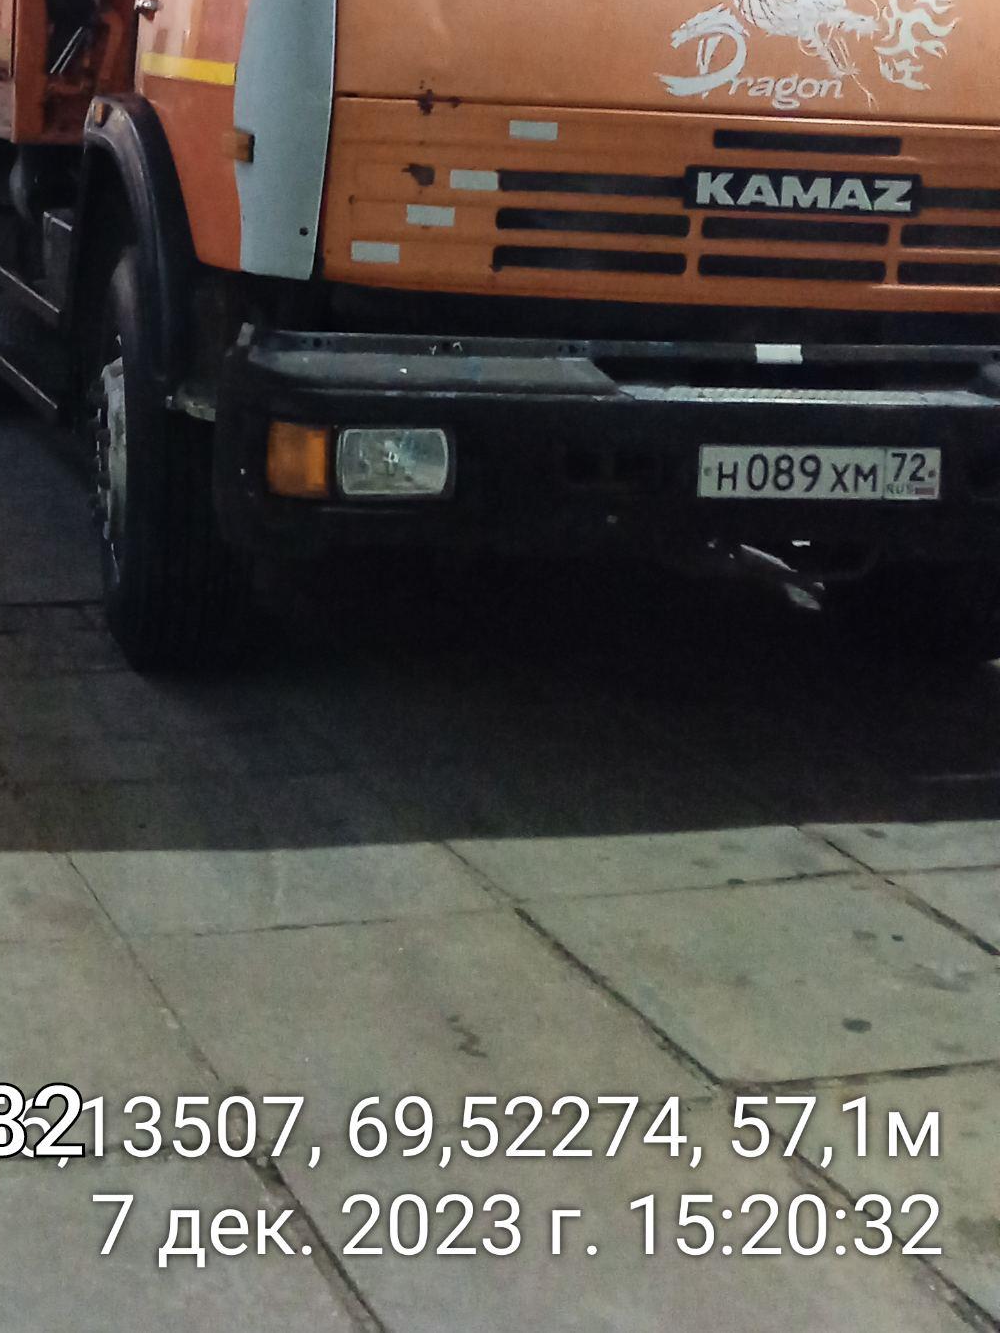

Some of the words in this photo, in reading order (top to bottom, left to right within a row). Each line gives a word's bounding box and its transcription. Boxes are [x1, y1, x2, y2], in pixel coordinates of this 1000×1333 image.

[654, 3, 844, 110] Dragon
[695, 171, 913, 212] KAMAZ
[890, 453, 927, 482] 72
